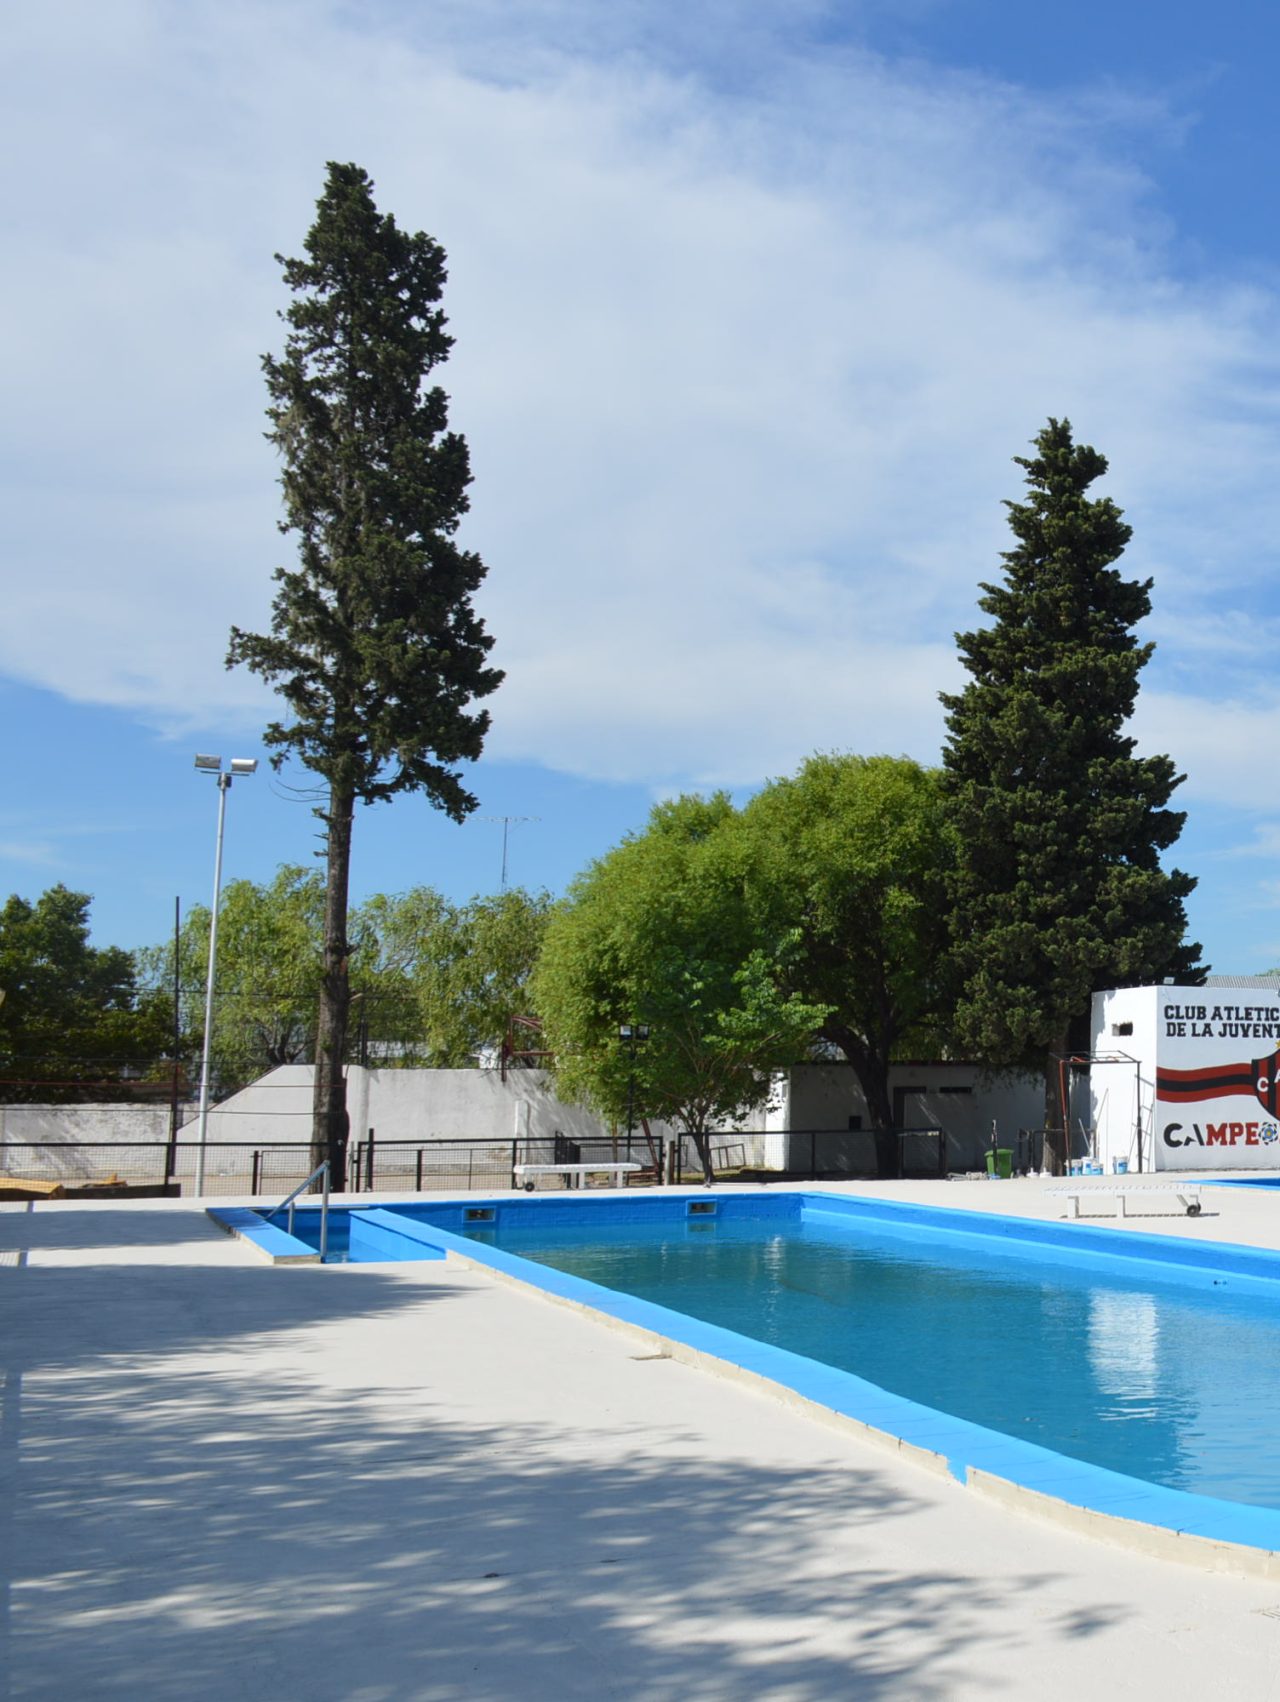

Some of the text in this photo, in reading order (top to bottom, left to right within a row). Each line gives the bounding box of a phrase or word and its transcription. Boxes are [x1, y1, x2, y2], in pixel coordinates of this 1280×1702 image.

[1164, 1005, 1207, 1020] CLUB
[1166, 1022, 1187, 1037] DE
[1191, 1023, 1214, 1038] LA
